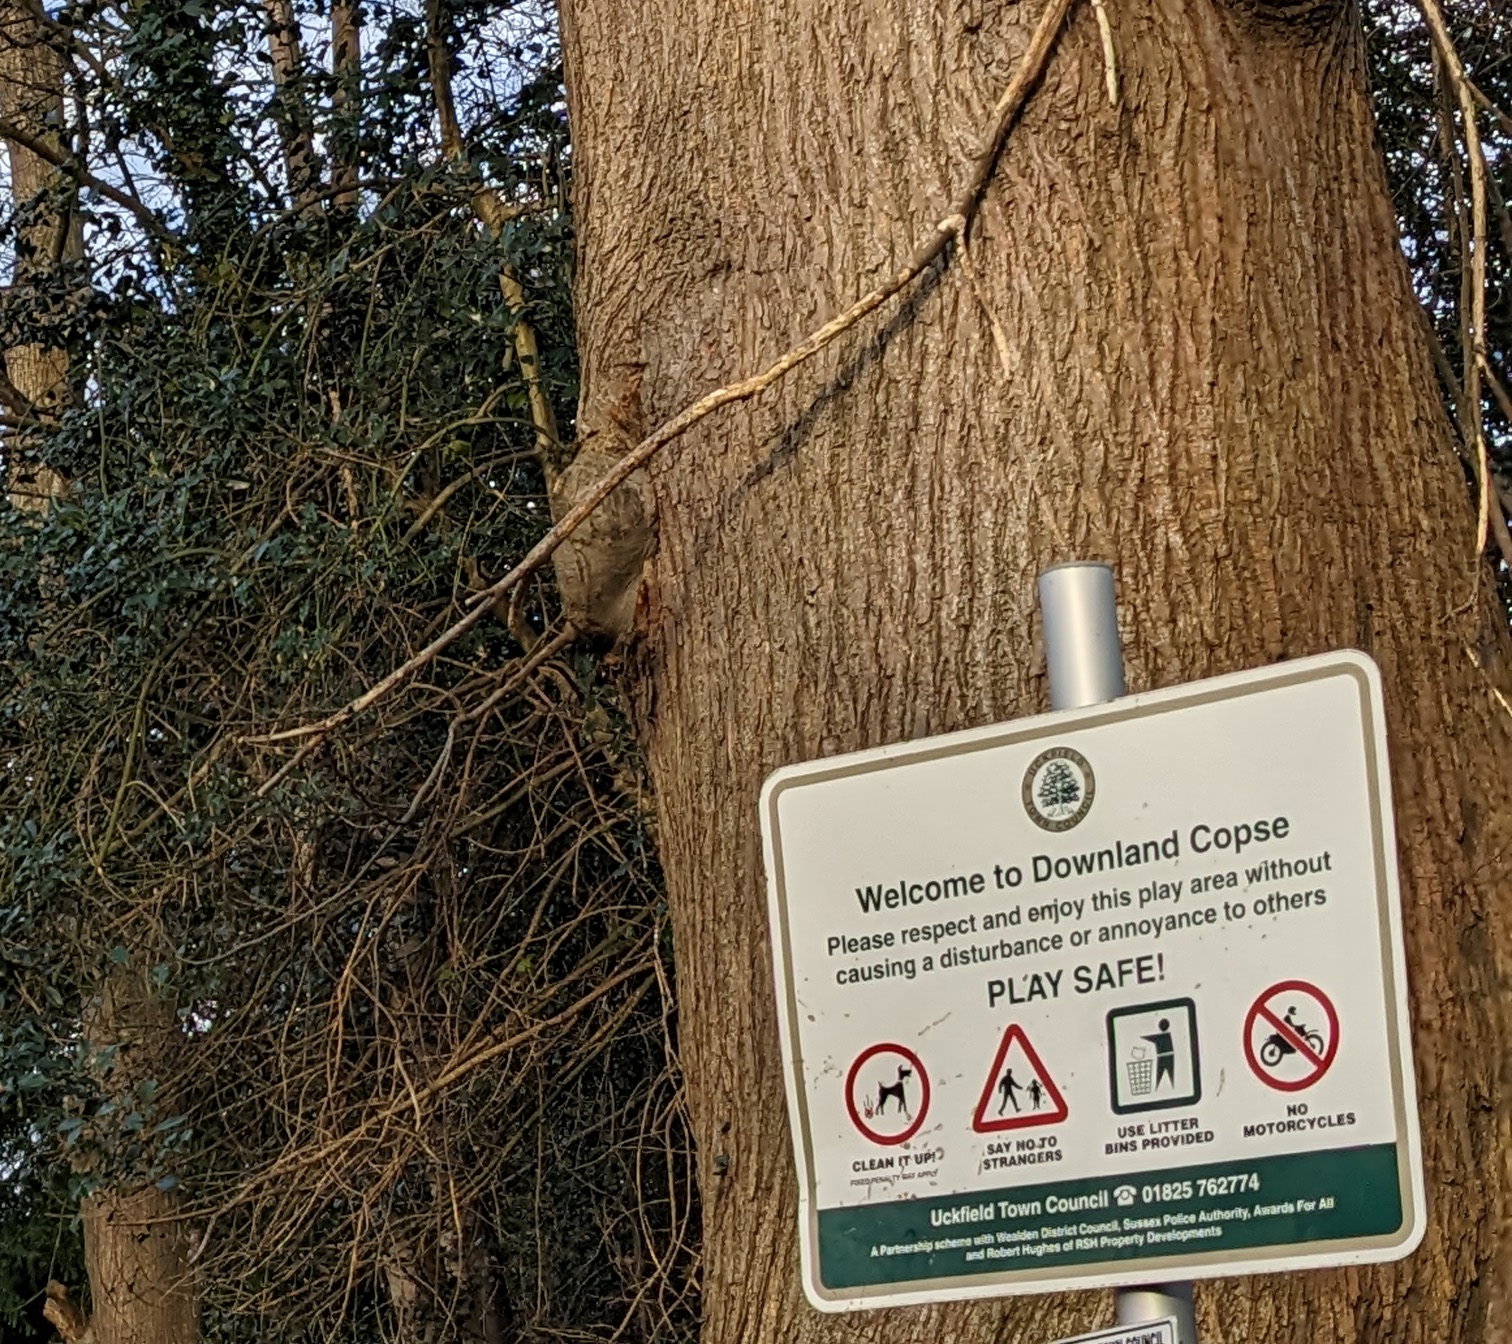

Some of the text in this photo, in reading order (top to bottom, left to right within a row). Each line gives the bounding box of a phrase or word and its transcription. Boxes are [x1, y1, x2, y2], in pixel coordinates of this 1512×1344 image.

[1025, 791, 1092, 830] TOWN COUNCIL
[856, 816, 1289, 913] Welcome to Downland Copse
[828, 851, 1332, 956] Please respect and enjoy this play area without
[836, 888, 1327, 985] causing a disturbance or annoyance to others
[988, 953, 1164, 1007] PLAY SAFE!
[1117, 1117, 1199, 1139] USE LITTER
[1243, 1112, 1356, 1138] MOTORCYCLES
[1287, 1103, 1308, 1117] NO
[983, 1150, 1063, 1170] STRANGERS
[986, 1142, 1011, 1155] SAY
[1105, 1130, 1214, 1155] BINS PROVIDED
[852, 1156, 894, 1172] CLEAN
[898, 1155, 911, 1167] IT
[930, 1172, 1260, 1226] Uckfield Town Council 01825 762774
[870, 1246, 879, 1257] A
[880, 1239, 933, 1256] Partnership
[934, 1236, 972, 1249] scheme
[973, 1233, 995, 1246] with
[996, 1229, 1039, 1243] Wealden
[1040, 1224, 1078, 1239] District
[1123, 1217, 1161, 1231] Sussex
[1163, 1212, 1196, 1226] Police
[1253, 1202, 1295, 1217] Awards
[1296, 1199, 1317, 1213] For
[1318, 1197, 1335, 1210] All
[965, 1225, 1223, 1262] and Robert Hughes of RSH Property Developments
